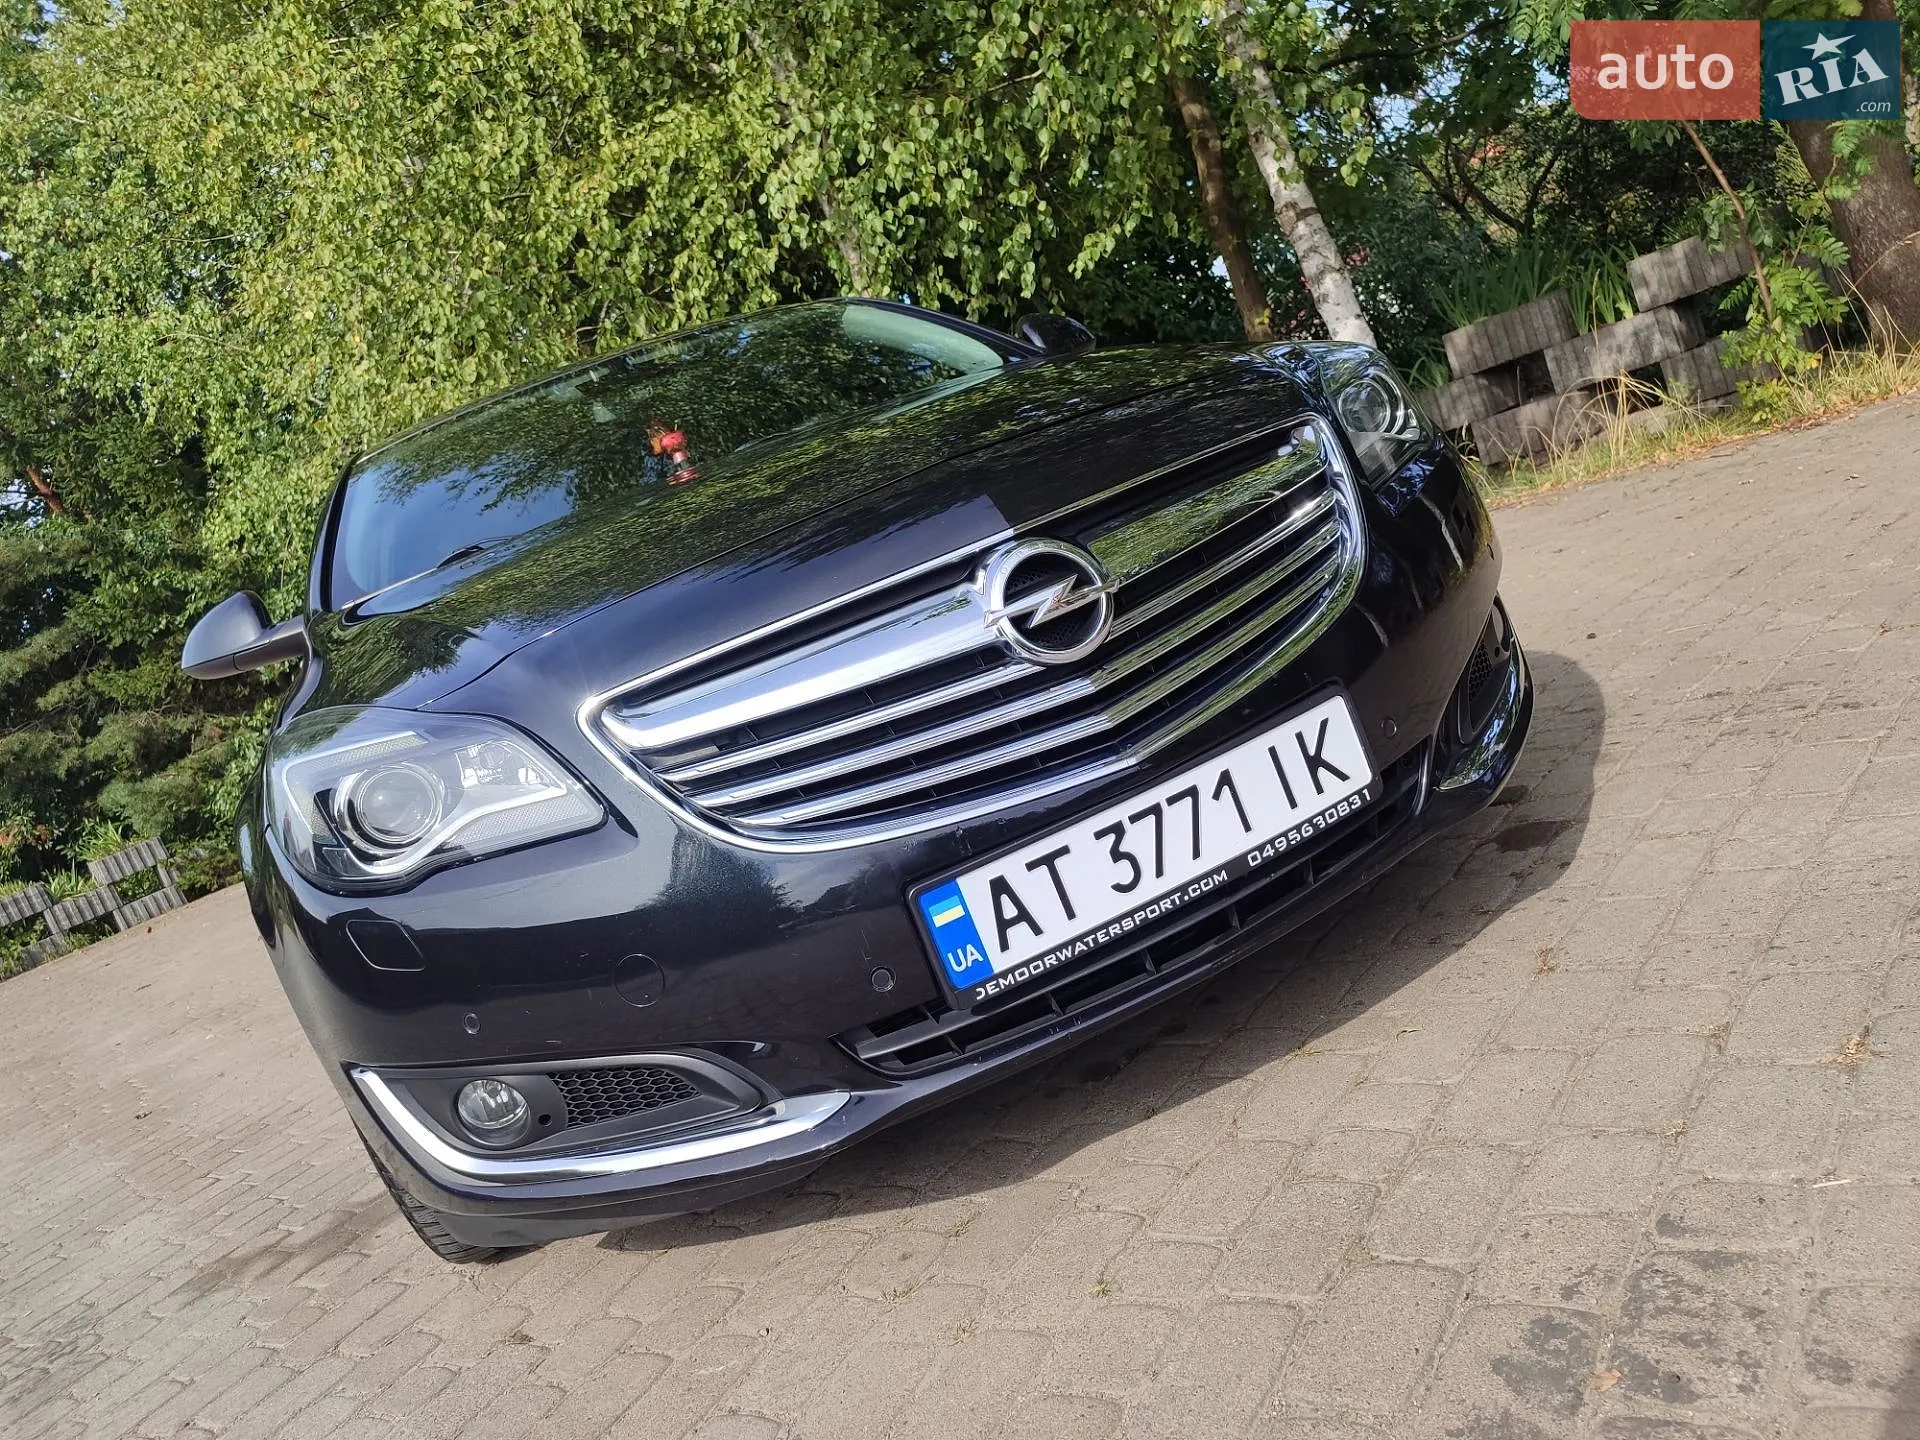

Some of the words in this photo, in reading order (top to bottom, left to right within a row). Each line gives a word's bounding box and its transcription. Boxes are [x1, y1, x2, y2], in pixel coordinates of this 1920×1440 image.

[988, 844, 1077, 953] AT
[1093, 768, 1252, 894] 3771
[1267, 717, 1351, 811] IK
[1247, 788, 1371, 867] 0495630831
[948, 943, 984, 973] UA
